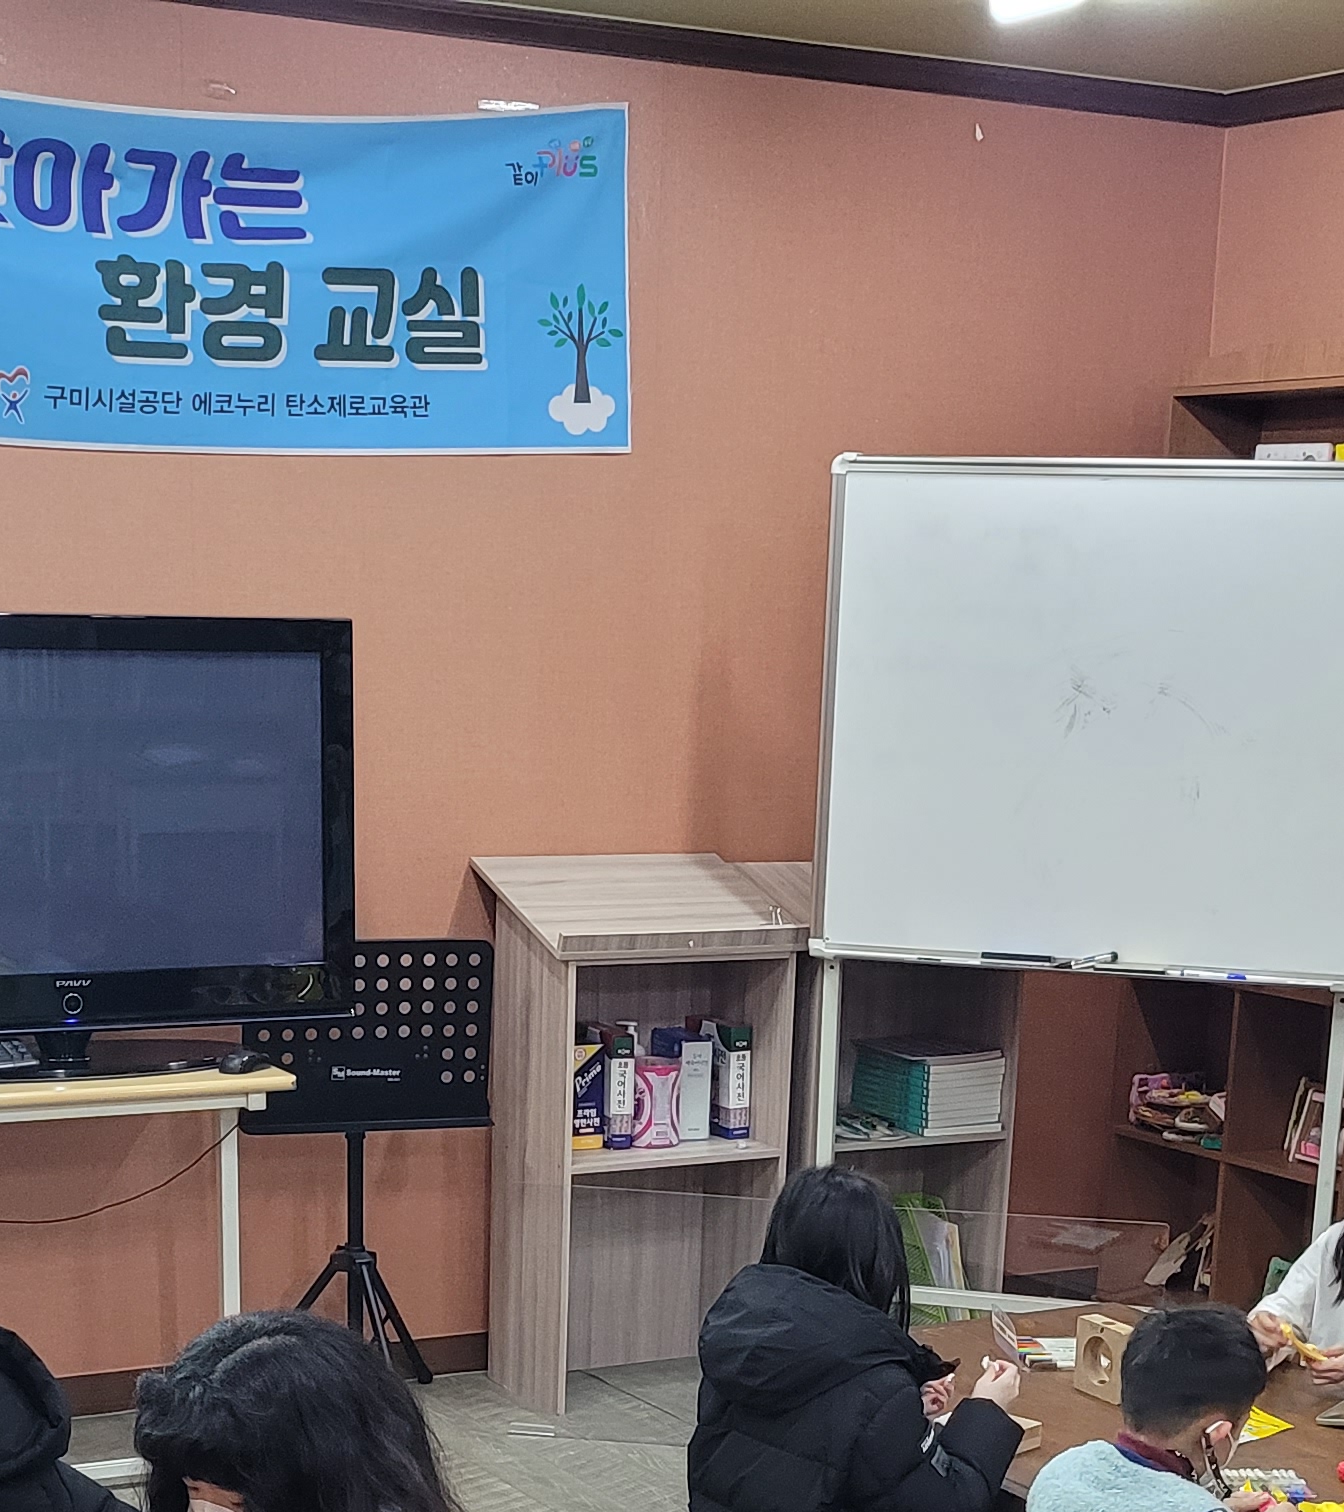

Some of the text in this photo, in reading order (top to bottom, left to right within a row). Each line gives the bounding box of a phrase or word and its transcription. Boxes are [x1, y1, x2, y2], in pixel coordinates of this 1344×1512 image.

[94, 254, 486, 366] 환경 교실
[43, 384, 431, 420] 구미시설공단 에코누리 탄소제로교육관
